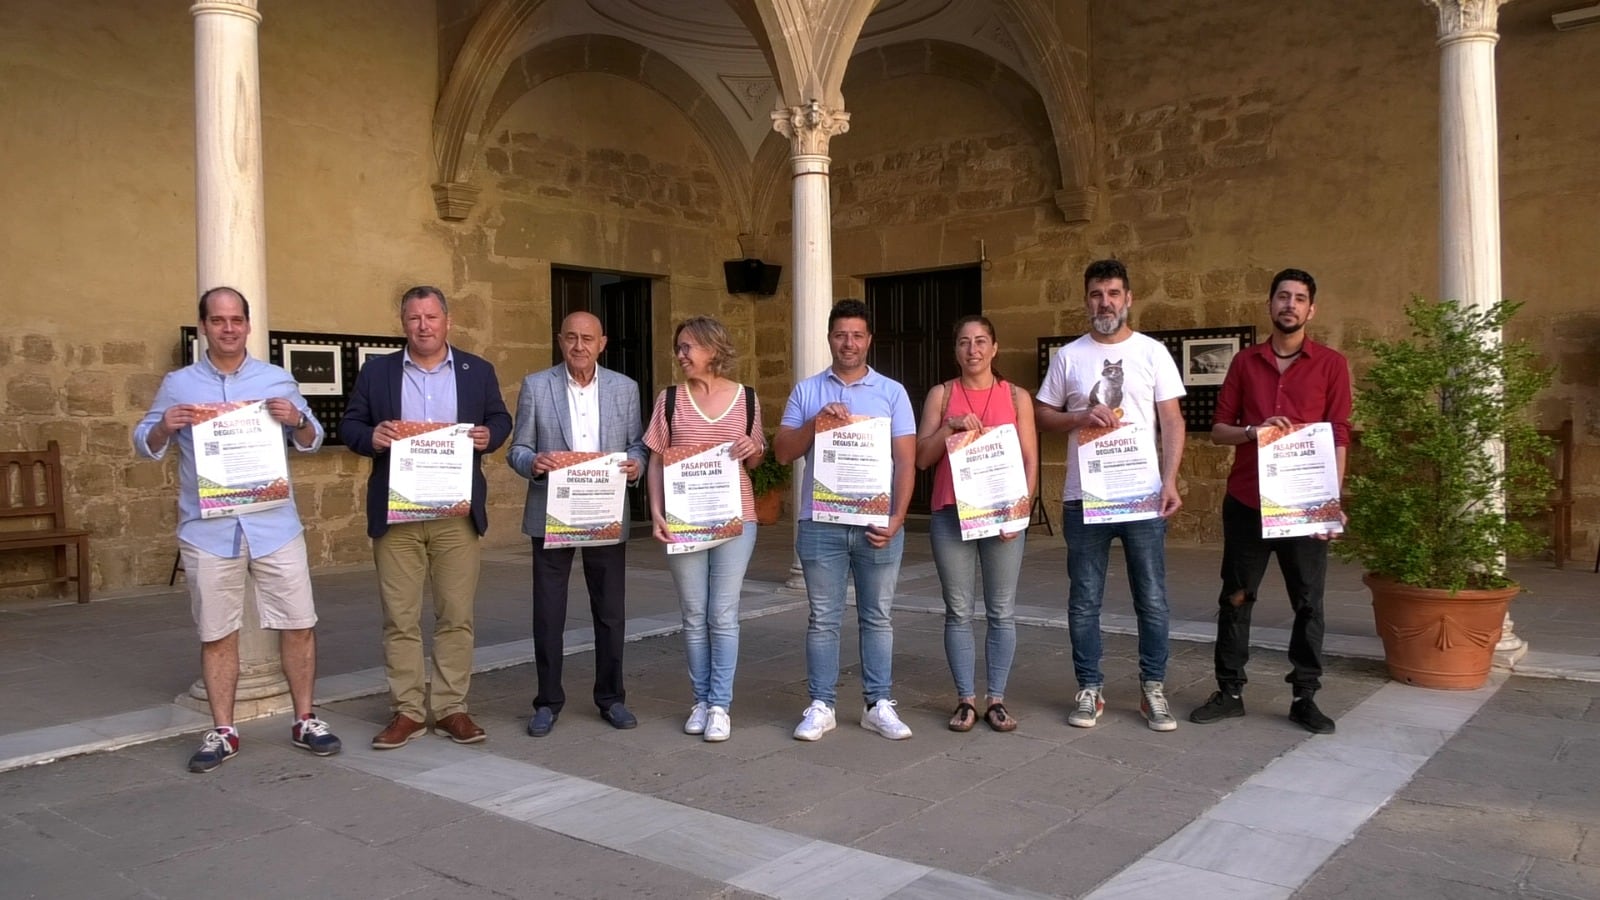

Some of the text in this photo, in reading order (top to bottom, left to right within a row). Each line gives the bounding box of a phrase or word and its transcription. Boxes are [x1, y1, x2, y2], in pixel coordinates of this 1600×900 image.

[213, 419, 260, 428] PASAPORTE
[214, 428, 243, 436] DEGUSTA
[410, 440, 455, 448] PASAPORTE
[1095, 438, 1137, 448] PASAPORTE
[1273, 441, 1315, 451] PASAPORTE
[965, 442, 1003, 456] PASAPORTE
[1096, 447, 1122, 455] DEGUSTA
[681, 461, 722, 470] PASAPORTE
[567, 469, 609, 477] PASAPORTE
